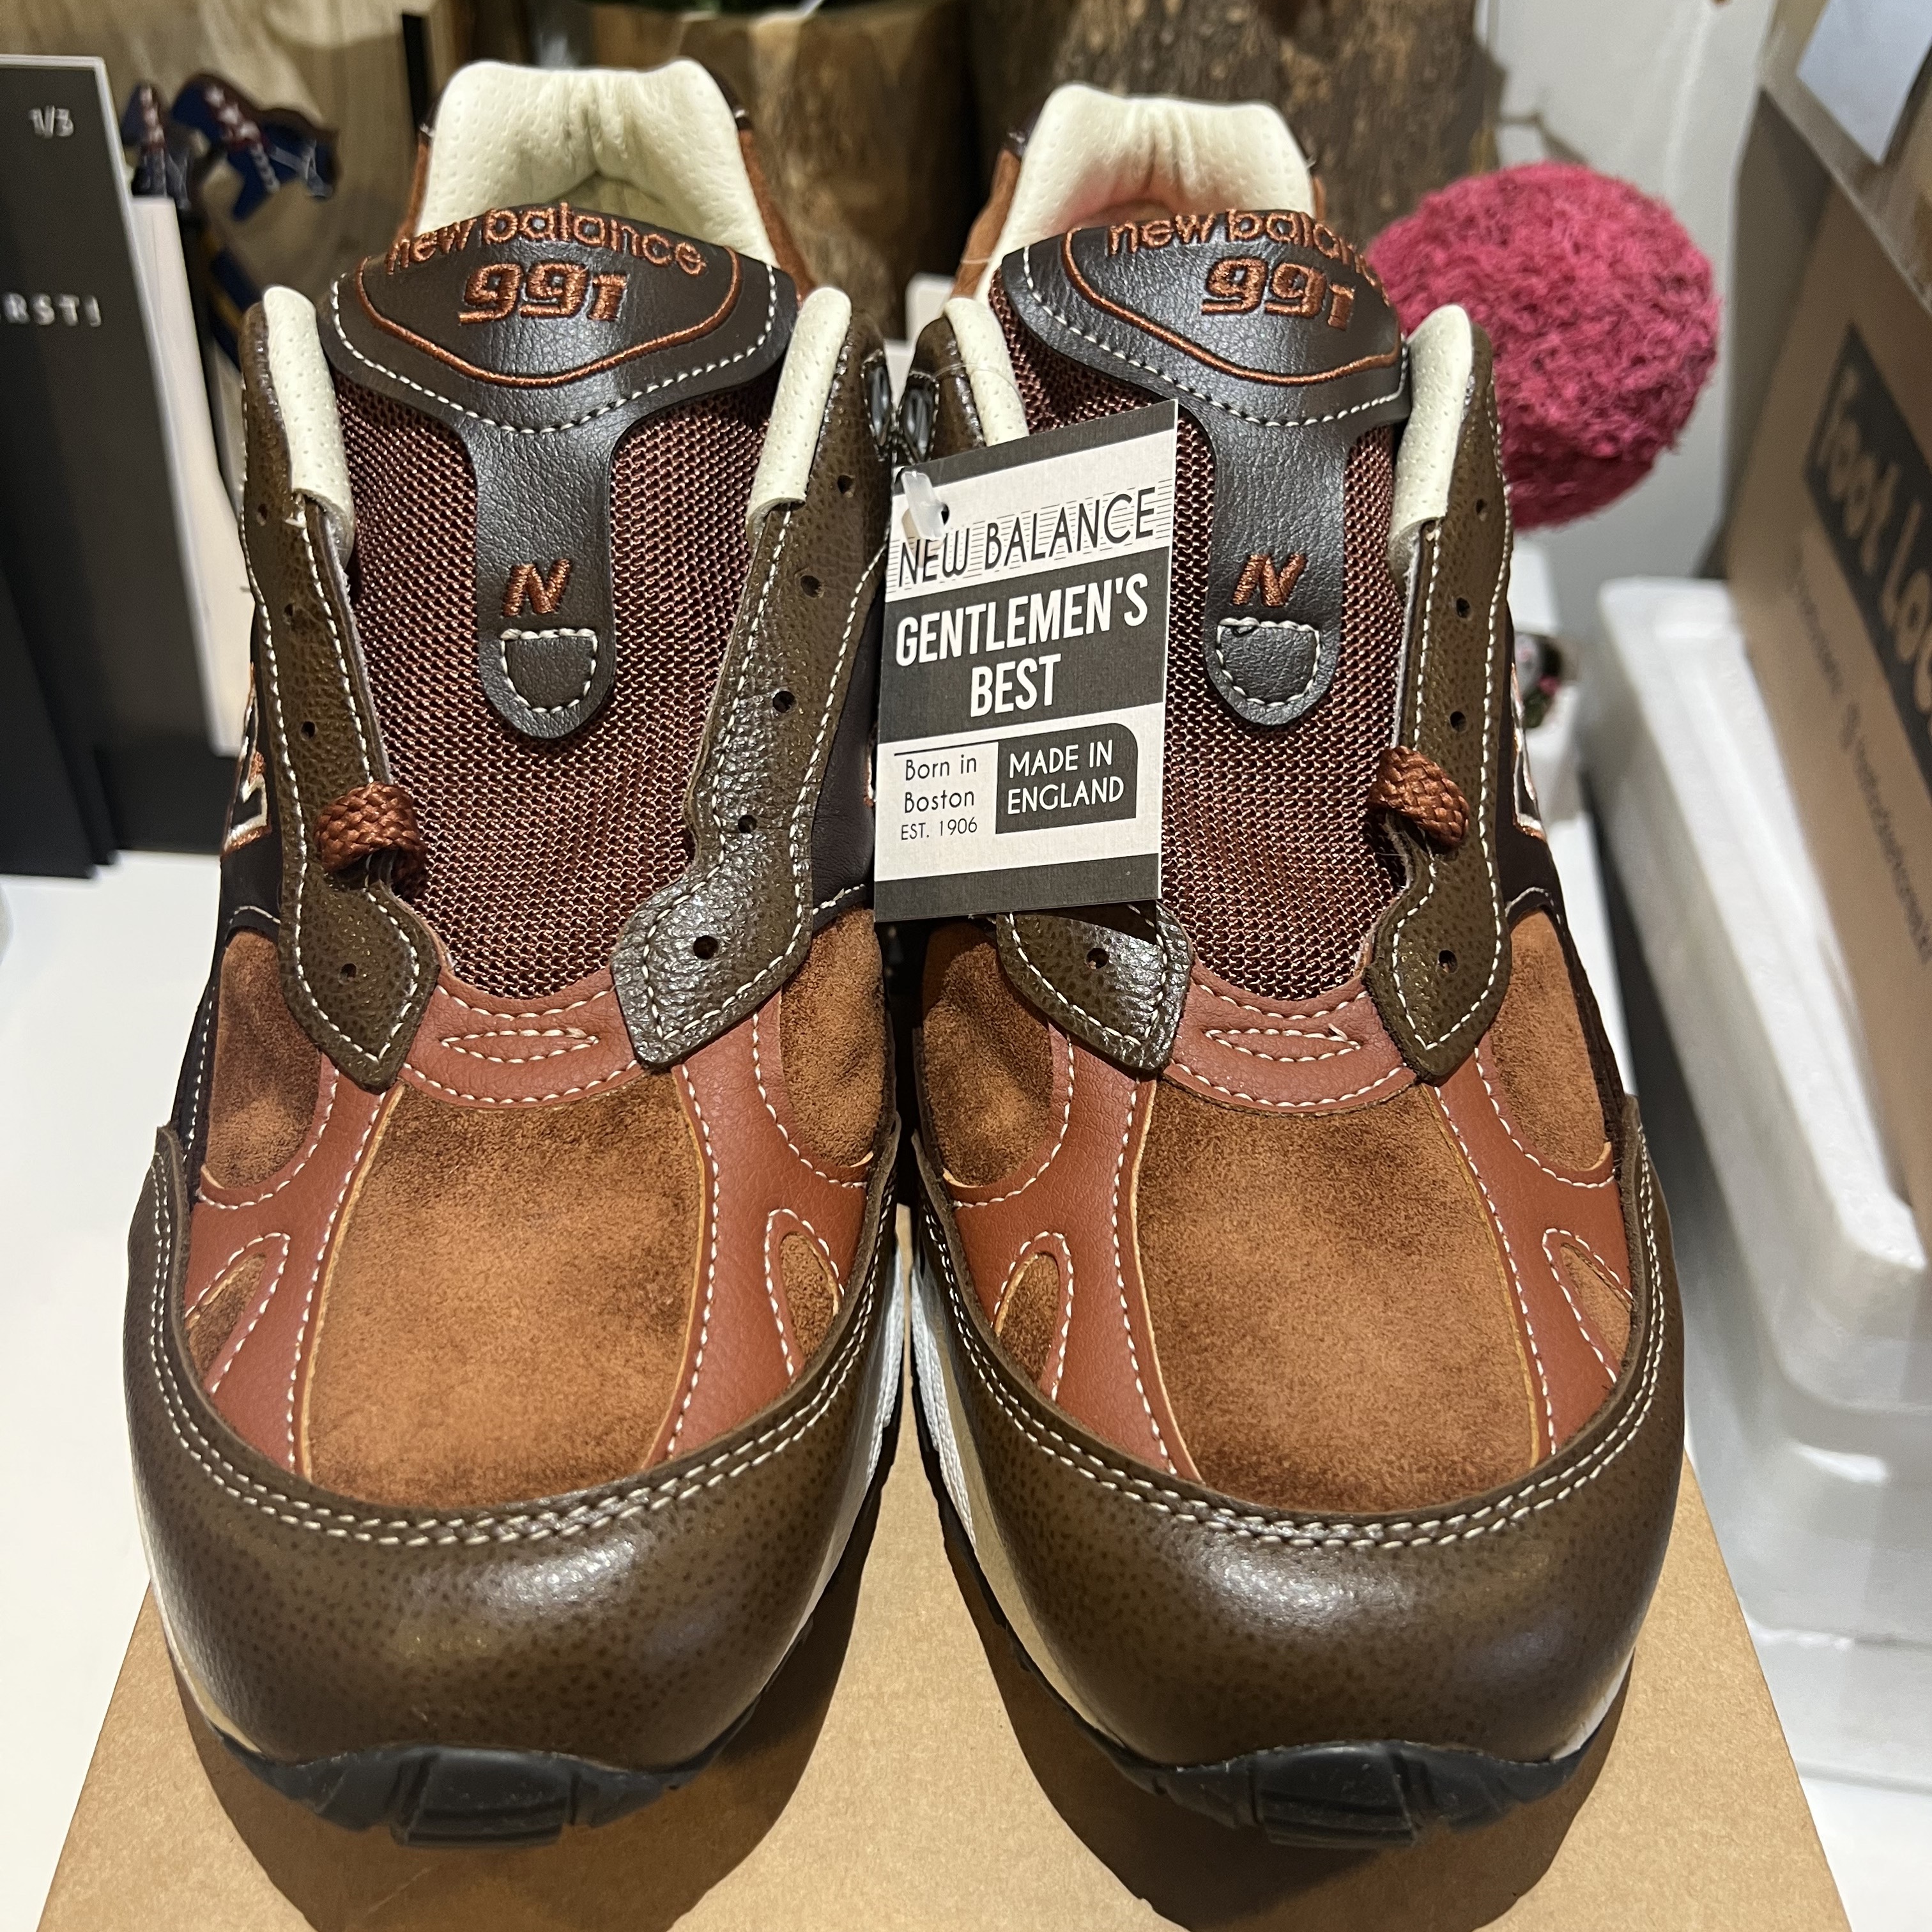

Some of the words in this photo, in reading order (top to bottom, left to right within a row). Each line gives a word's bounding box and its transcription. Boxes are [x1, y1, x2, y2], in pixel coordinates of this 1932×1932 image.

[385, 218, 477, 275] new
[482, 202, 707, 276] balance
[1108, 212, 1214, 255] new
[458, 261, 628, 326] 991
[1200, 257, 1356, 331] 991
[898, 527, 970, 588] NEW
[985, 486, 1156, 571] BALANCE
[895, 572, 1149, 667] GENTLEMEN'S
[970, 653, 1062, 718] BEST
[905, 758, 950, 781] Born
[960, 754, 977, 774] in
[1009, 744, 1079, 779] MADE
[1089, 739, 1113, 768] IN
[904, 789, 975, 814] Boston
[1007, 775, 1124, 815] ENGLAND
[900, 822, 930, 841] EST.
[939, 816, 977, 836] 1906
